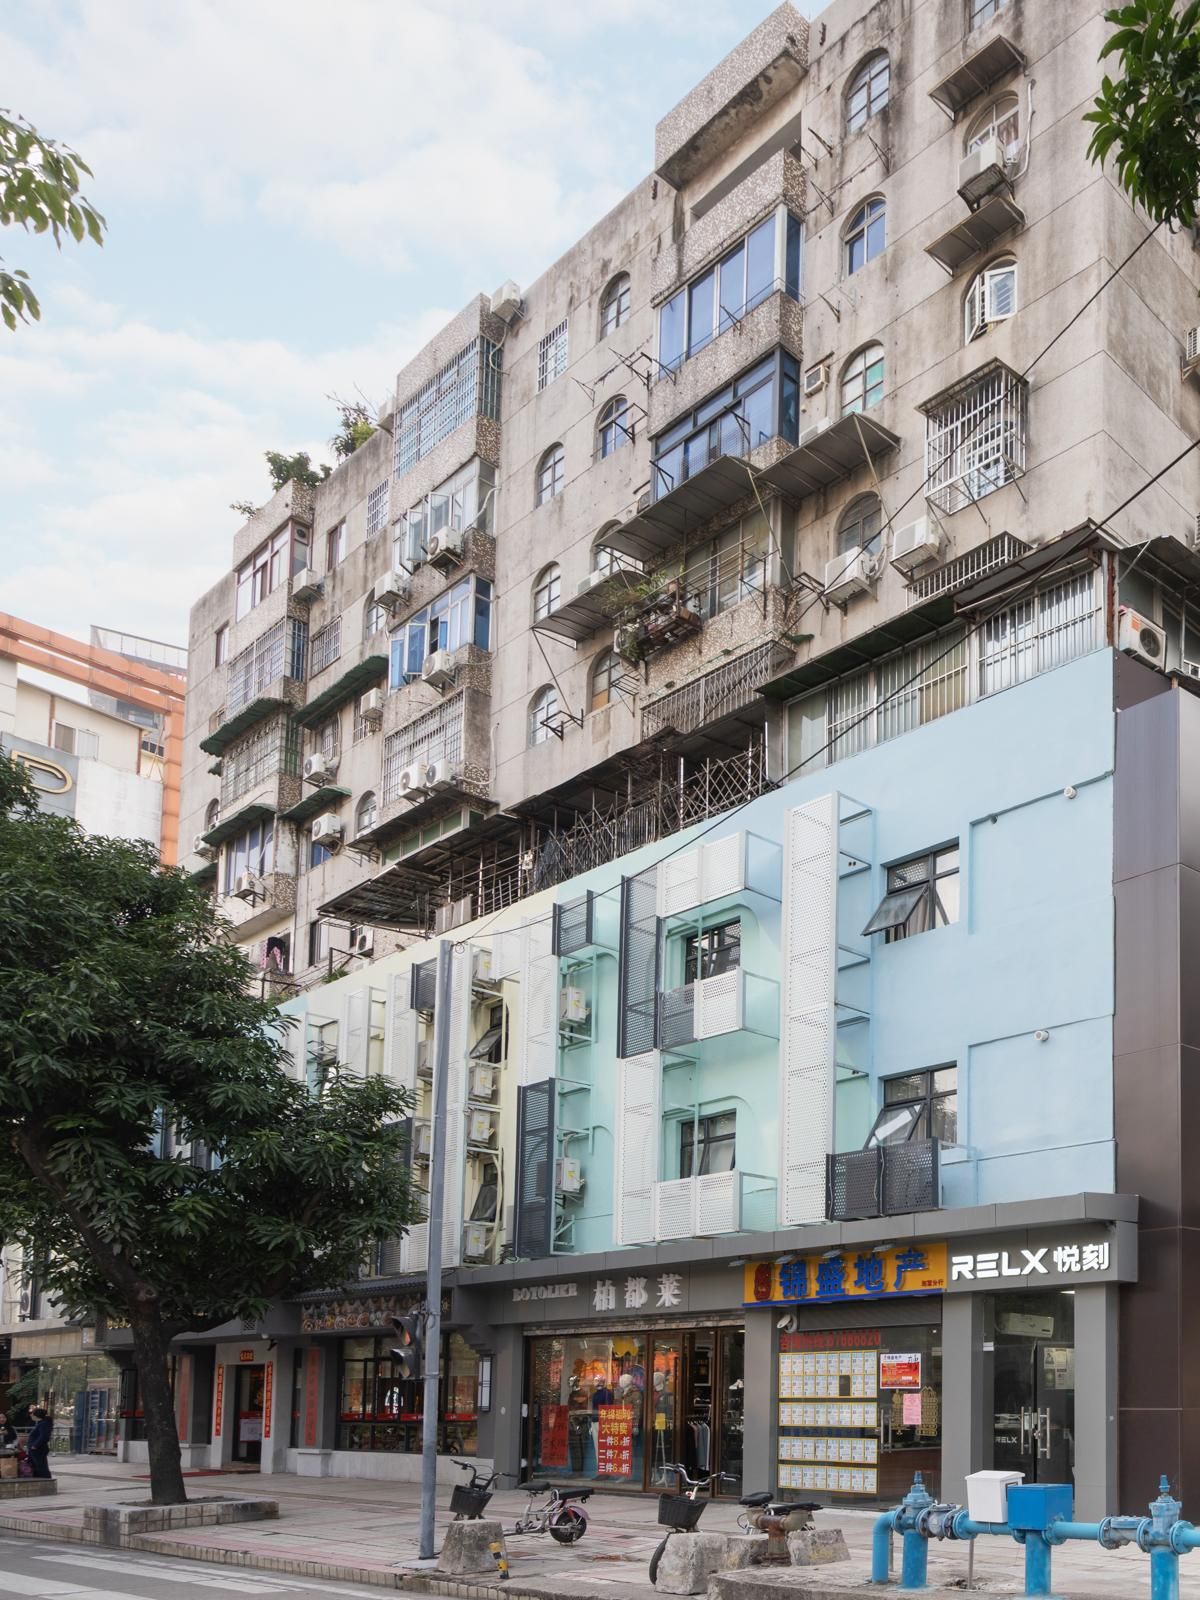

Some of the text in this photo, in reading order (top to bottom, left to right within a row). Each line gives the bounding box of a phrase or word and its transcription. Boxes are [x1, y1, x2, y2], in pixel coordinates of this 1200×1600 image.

[779, 1247, 930, 1299] 锦盛地产
[951, 1242, 1110, 1280] RELX 悦刻
[592, 1273, 684, 1311] 柏都莱
